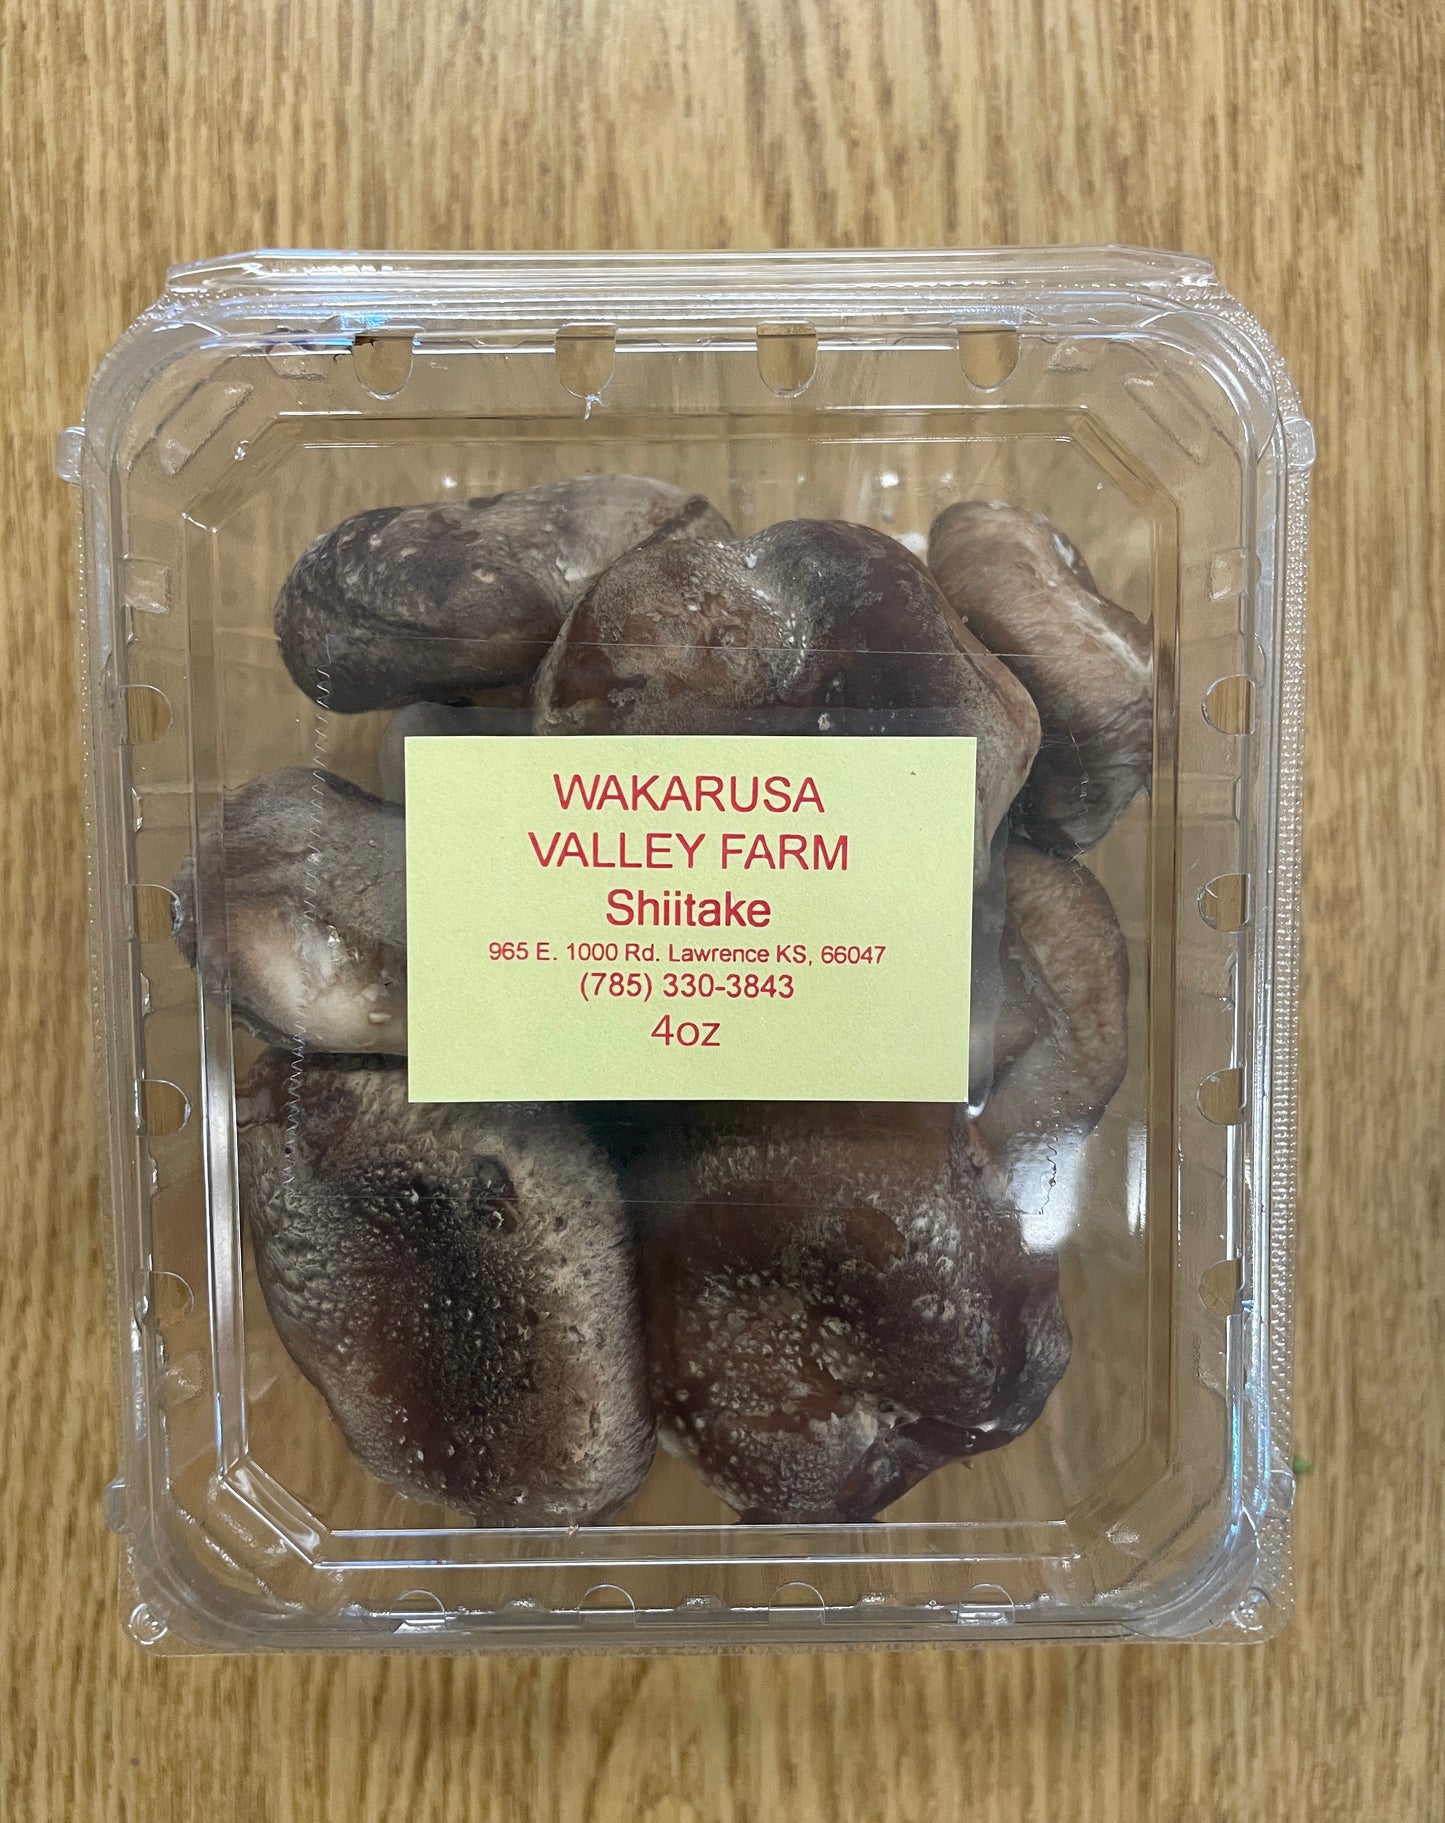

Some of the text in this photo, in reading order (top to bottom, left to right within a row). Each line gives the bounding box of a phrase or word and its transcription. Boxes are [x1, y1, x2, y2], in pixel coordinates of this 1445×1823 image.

[552, 773, 826, 814] WAKARUSA
[527, 831, 849, 871] VALLEY FARM
[605, 888, 772, 928] Shiitake
[488, 942, 887, 967] 965 E. 1000 Rd. Lawrence KS, 66047
[580, 972, 795, 1002] (785) 330-3843
[650, 1014, 721, 1047] 4oz
